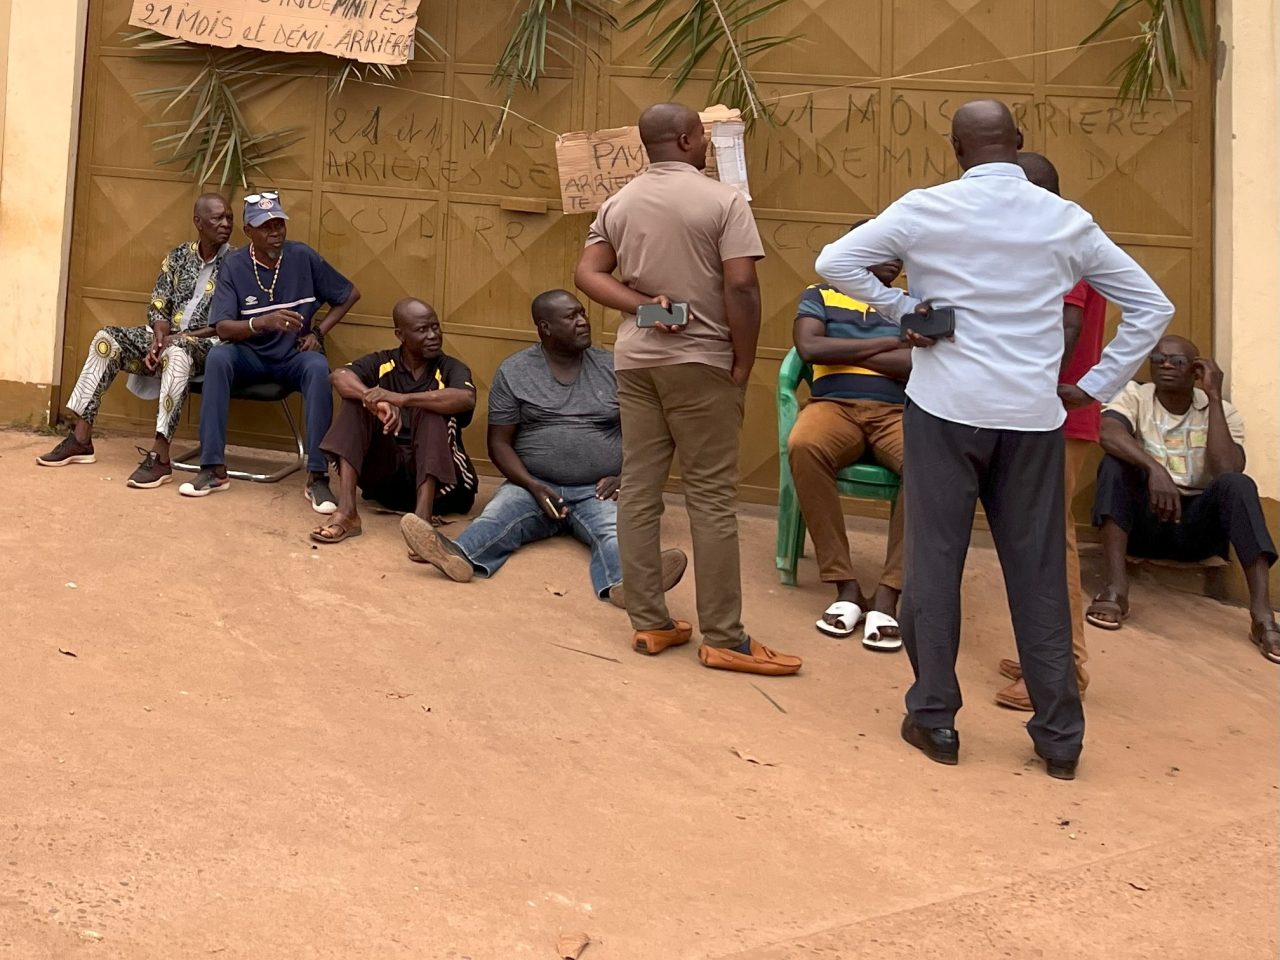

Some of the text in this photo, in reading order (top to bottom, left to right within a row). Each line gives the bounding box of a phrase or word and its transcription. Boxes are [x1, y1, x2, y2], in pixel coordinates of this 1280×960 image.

[139, 2, 173, 26] 21
[1011, 101, 1164, 137] RRIERES
[593, 142, 650, 173] PAY
